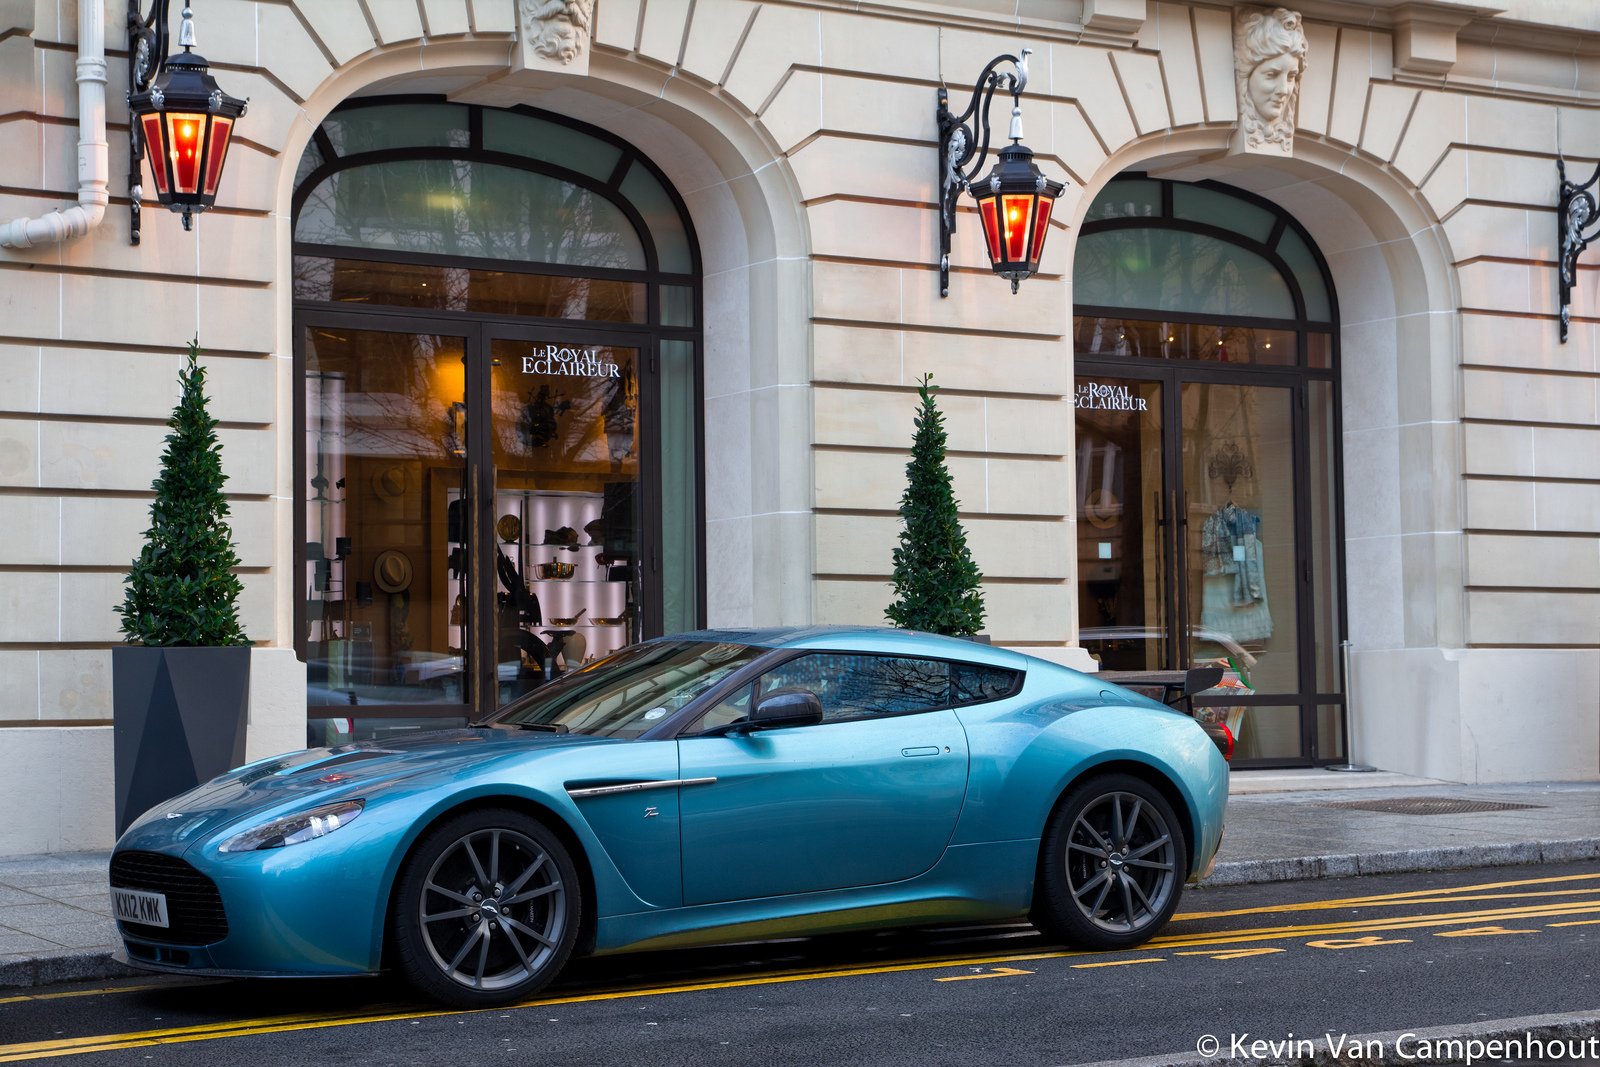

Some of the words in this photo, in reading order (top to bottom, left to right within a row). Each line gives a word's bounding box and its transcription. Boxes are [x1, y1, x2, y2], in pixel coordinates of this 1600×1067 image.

[533, 347, 546, 358] LE
[546, 345, 602, 364] ROYAL
[522, 356, 621, 378] ECLAIREUR
[1089, 382, 1133, 400] ROYAL
[115, 892, 139, 919] KX12
[139, 895, 162, 923] KWK
